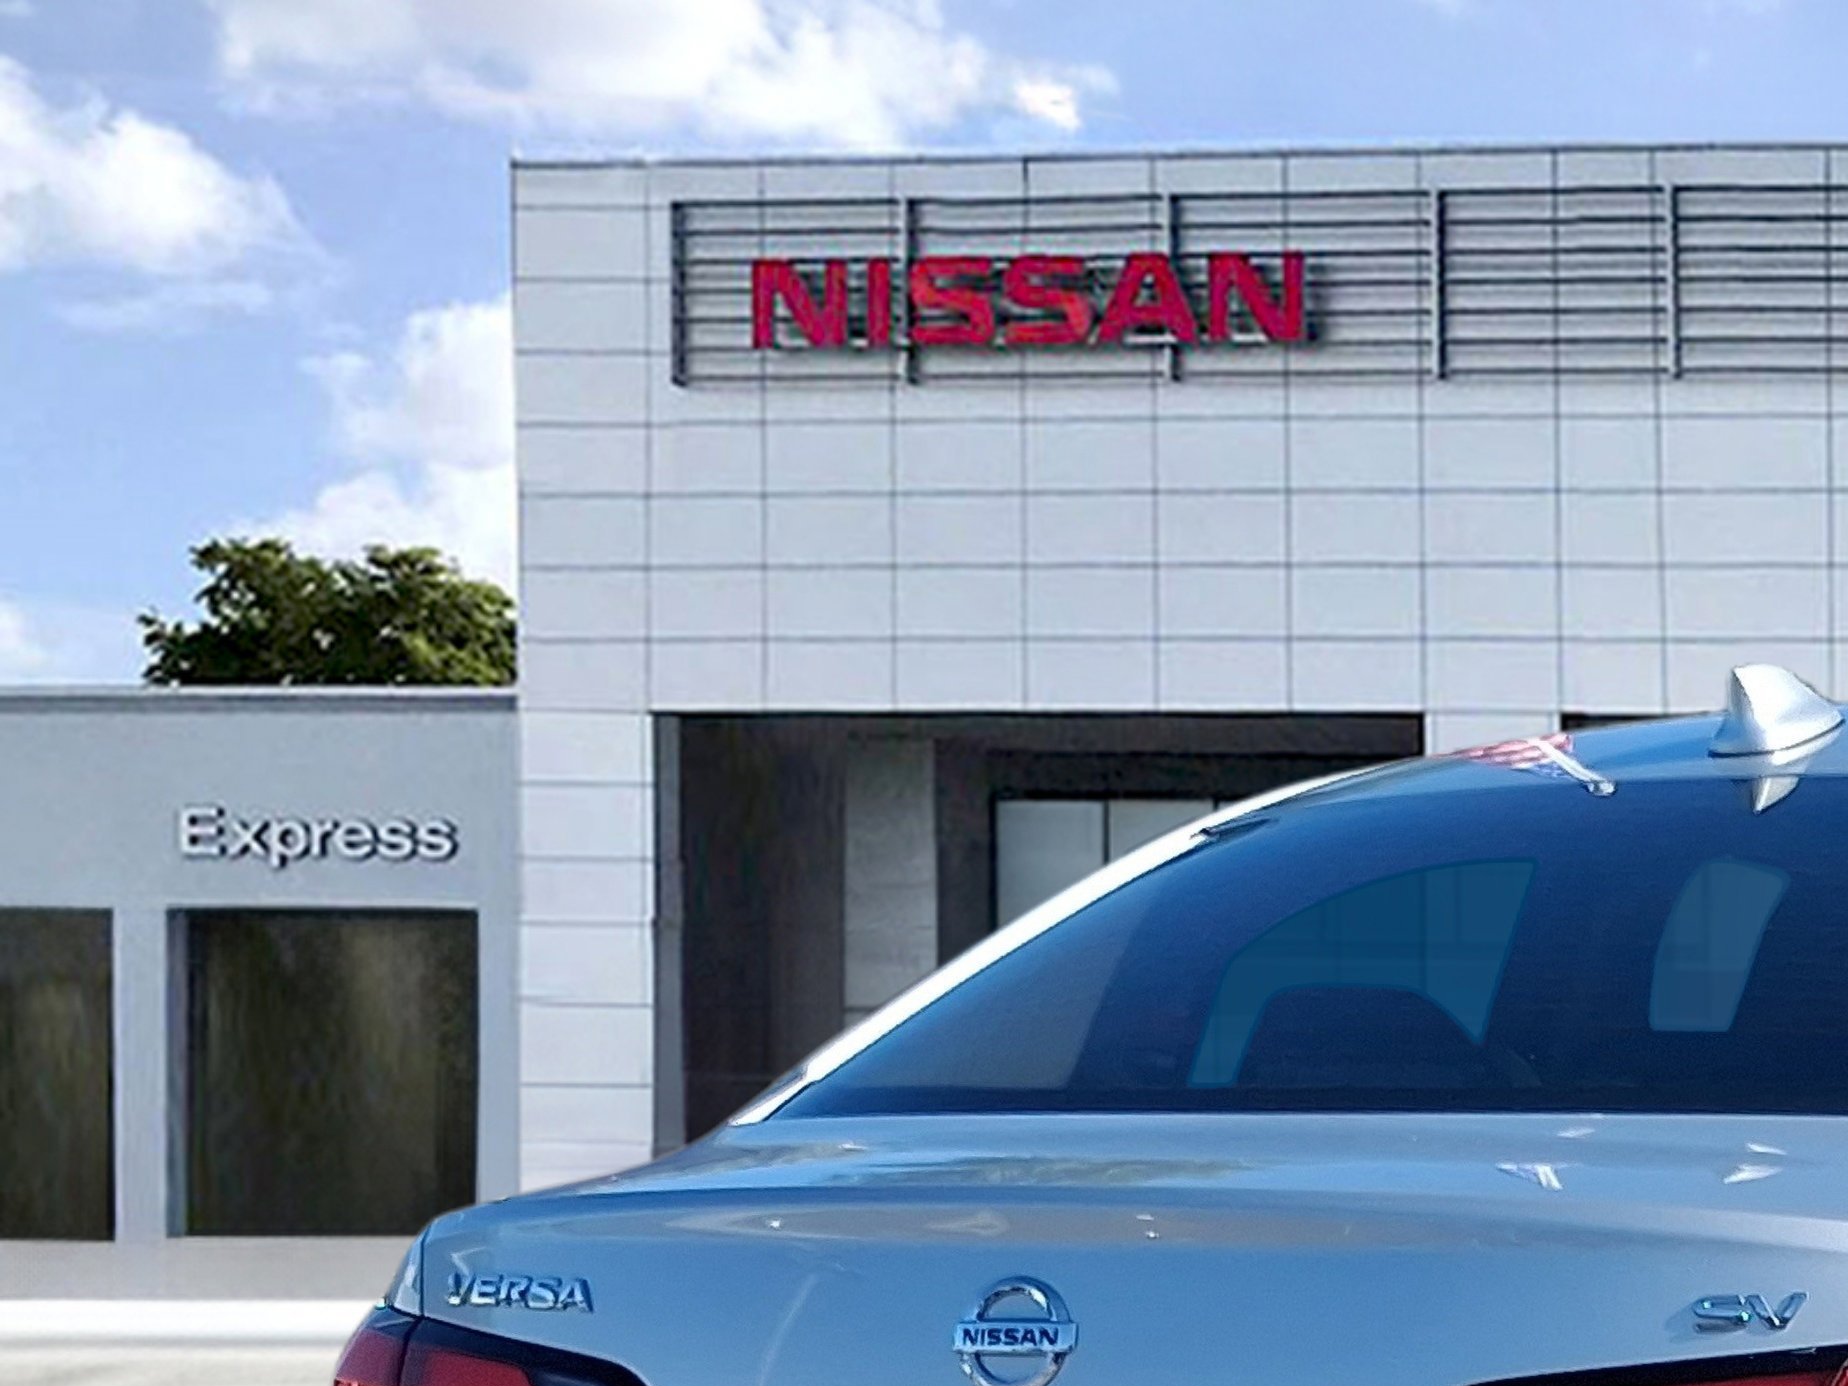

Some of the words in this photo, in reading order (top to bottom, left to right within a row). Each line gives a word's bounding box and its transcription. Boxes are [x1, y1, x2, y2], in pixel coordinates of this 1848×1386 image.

[752, 251, 1304, 348] NISSAN
[180, 805, 459, 868] Express
[448, 1272, 594, 1313] VERSA
[1693, 1292, 1808, 1333] SV
[962, 1327, 1059, 1346] NISSAN
